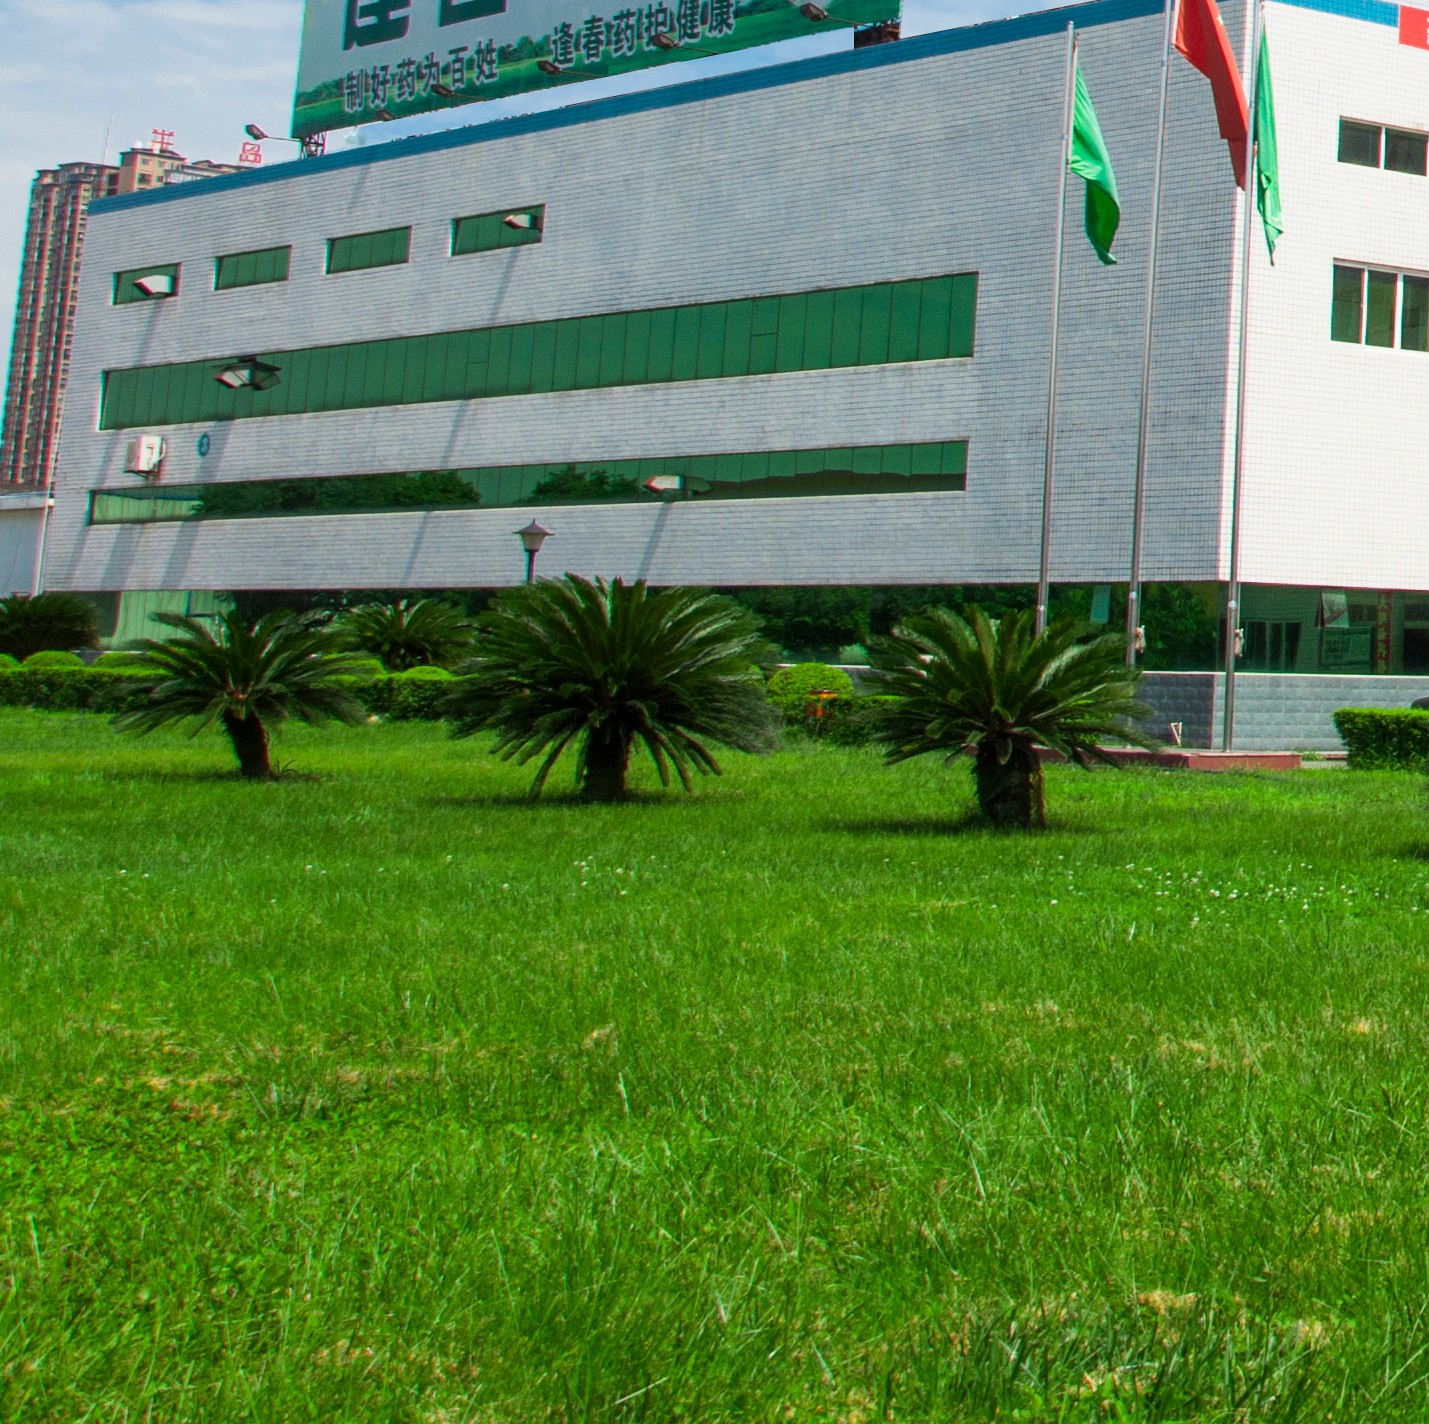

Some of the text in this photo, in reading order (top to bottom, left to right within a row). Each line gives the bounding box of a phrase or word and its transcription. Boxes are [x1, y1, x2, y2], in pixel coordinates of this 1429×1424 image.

[345, 38, 498, 112] 制好药为百姓
